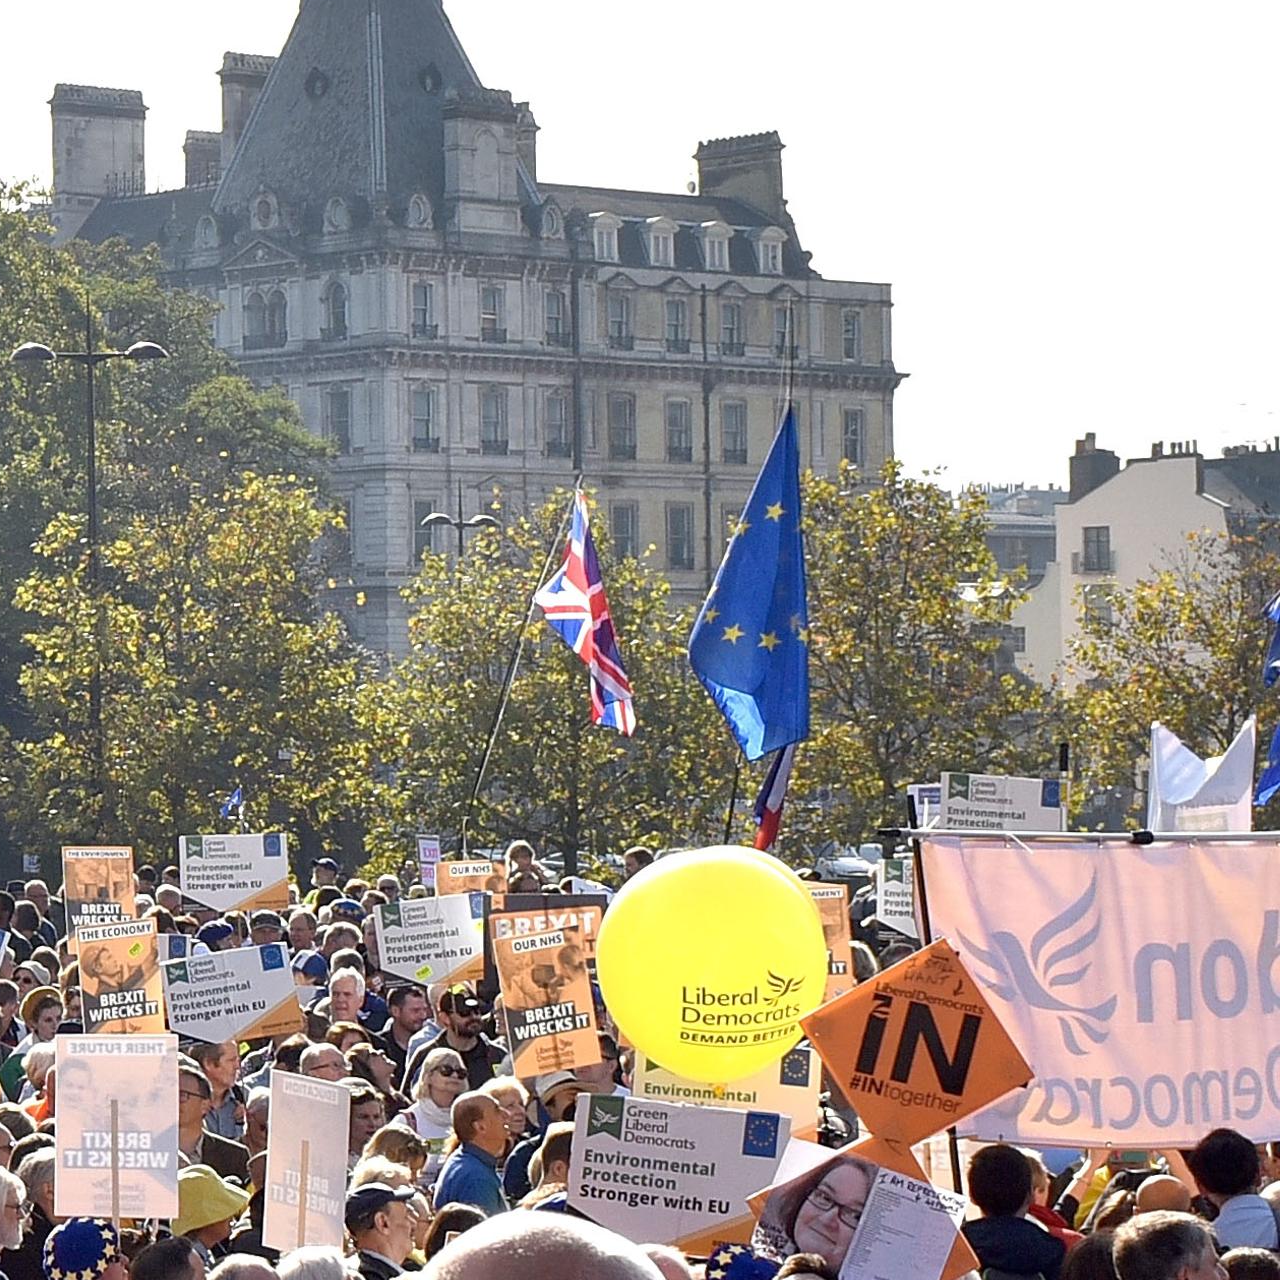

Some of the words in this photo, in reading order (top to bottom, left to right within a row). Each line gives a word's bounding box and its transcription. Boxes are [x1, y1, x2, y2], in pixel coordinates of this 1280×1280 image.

[971, 780, 996, 788] Green
[970, 796, 1013, 805] Democrats
[947, 807, 1026, 820] Environmental
[947, 817, 1004, 829] Protection
[186, 863, 252, 871] Environmental
[451, 866, 470, 874] OUR
[472, 865, 490, 873] NHS
[186, 873, 234, 881] Protection
[186, 882, 225, 891] Stronger
[228, 881, 248, 889] with
[81, 904, 121, 914] BREXIT
[71, 915, 119, 926] WRECKS
[495, 912, 596, 939] BREXIT
[81, 929, 101, 941] THE
[102, 923, 151, 938] ECONOMY
[384, 928, 460, 945] Environmental
[385, 941, 440, 954] Protection
[514, 938, 537, 952] OUR
[540, 934, 562, 947] NHS
[387, 951, 433, 965] Stronger
[434, 949, 457, 959] with
[459, 947, 472, 956] EU
[832, 962, 846, 974] IT
[100, 991, 145, 1007] BREXIT
[170, 981, 251, 1001] Environmental
[682, 986, 758, 1007] Liberal
[89, 1004, 142, 1022] WRECKS
[146, 1001, 158, 1015] IT
[172, 996, 231, 1012] Protection
[174, 1009, 222, 1023] Stronger
[224, 1004, 249, 1016] with
[252, 1000, 266, 1010] EU
[525, 1002, 575, 1022] BREXIT
[681, 1002, 800, 1026] Democrats
[514, 1019, 574, 1040] WRECKS
[576, 1014, 589, 1028] IT
[680, 1031, 748, 1045] DEMAND
[753, 1025, 797, 1042] BETTER
[644, 1082, 757, 1104] Environmntal
[849, 1073, 963, 1114] #INtogether
[627, 1105, 668, 1119] Green
[625, 1120, 668, 1134] Liberal
[624, 1132, 696, 1150] Democrats
[583, 1148, 716, 1177] Environmental
[582, 1167, 677, 1191] Protection
[879, 1173, 888, 1184] I
[891, 1175, 905, 1188] AM
[579, 1184, 659, 1208] Stronger
[663, 1195, 703, 1213] with
[708, 1200, 730, 1215] EU
